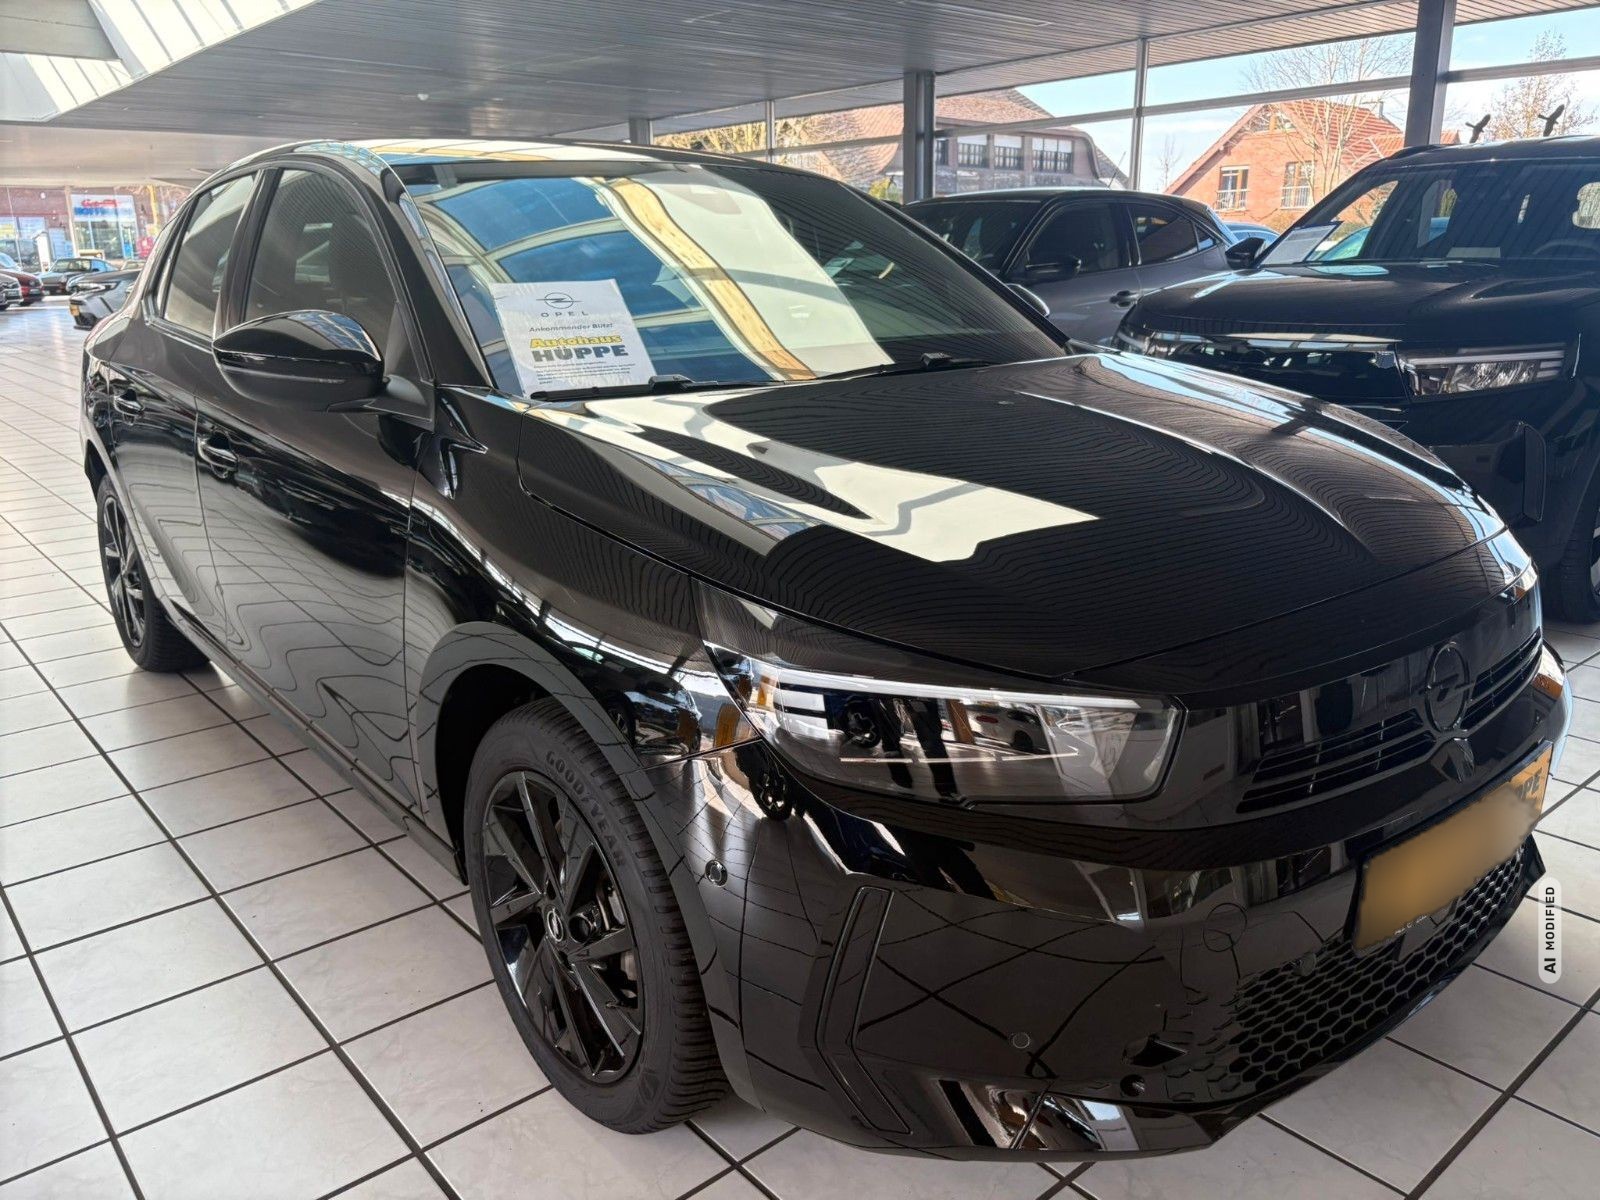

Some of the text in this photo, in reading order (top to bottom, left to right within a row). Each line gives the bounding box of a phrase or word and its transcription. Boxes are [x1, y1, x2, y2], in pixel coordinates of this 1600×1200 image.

[529, 324, 590, 332] Ankommender
[530, 335, 622, 348] Autohaus
[531, 344, 629, 362] HÜPPE
[545, 750, 627, 866] GOODYEAR
